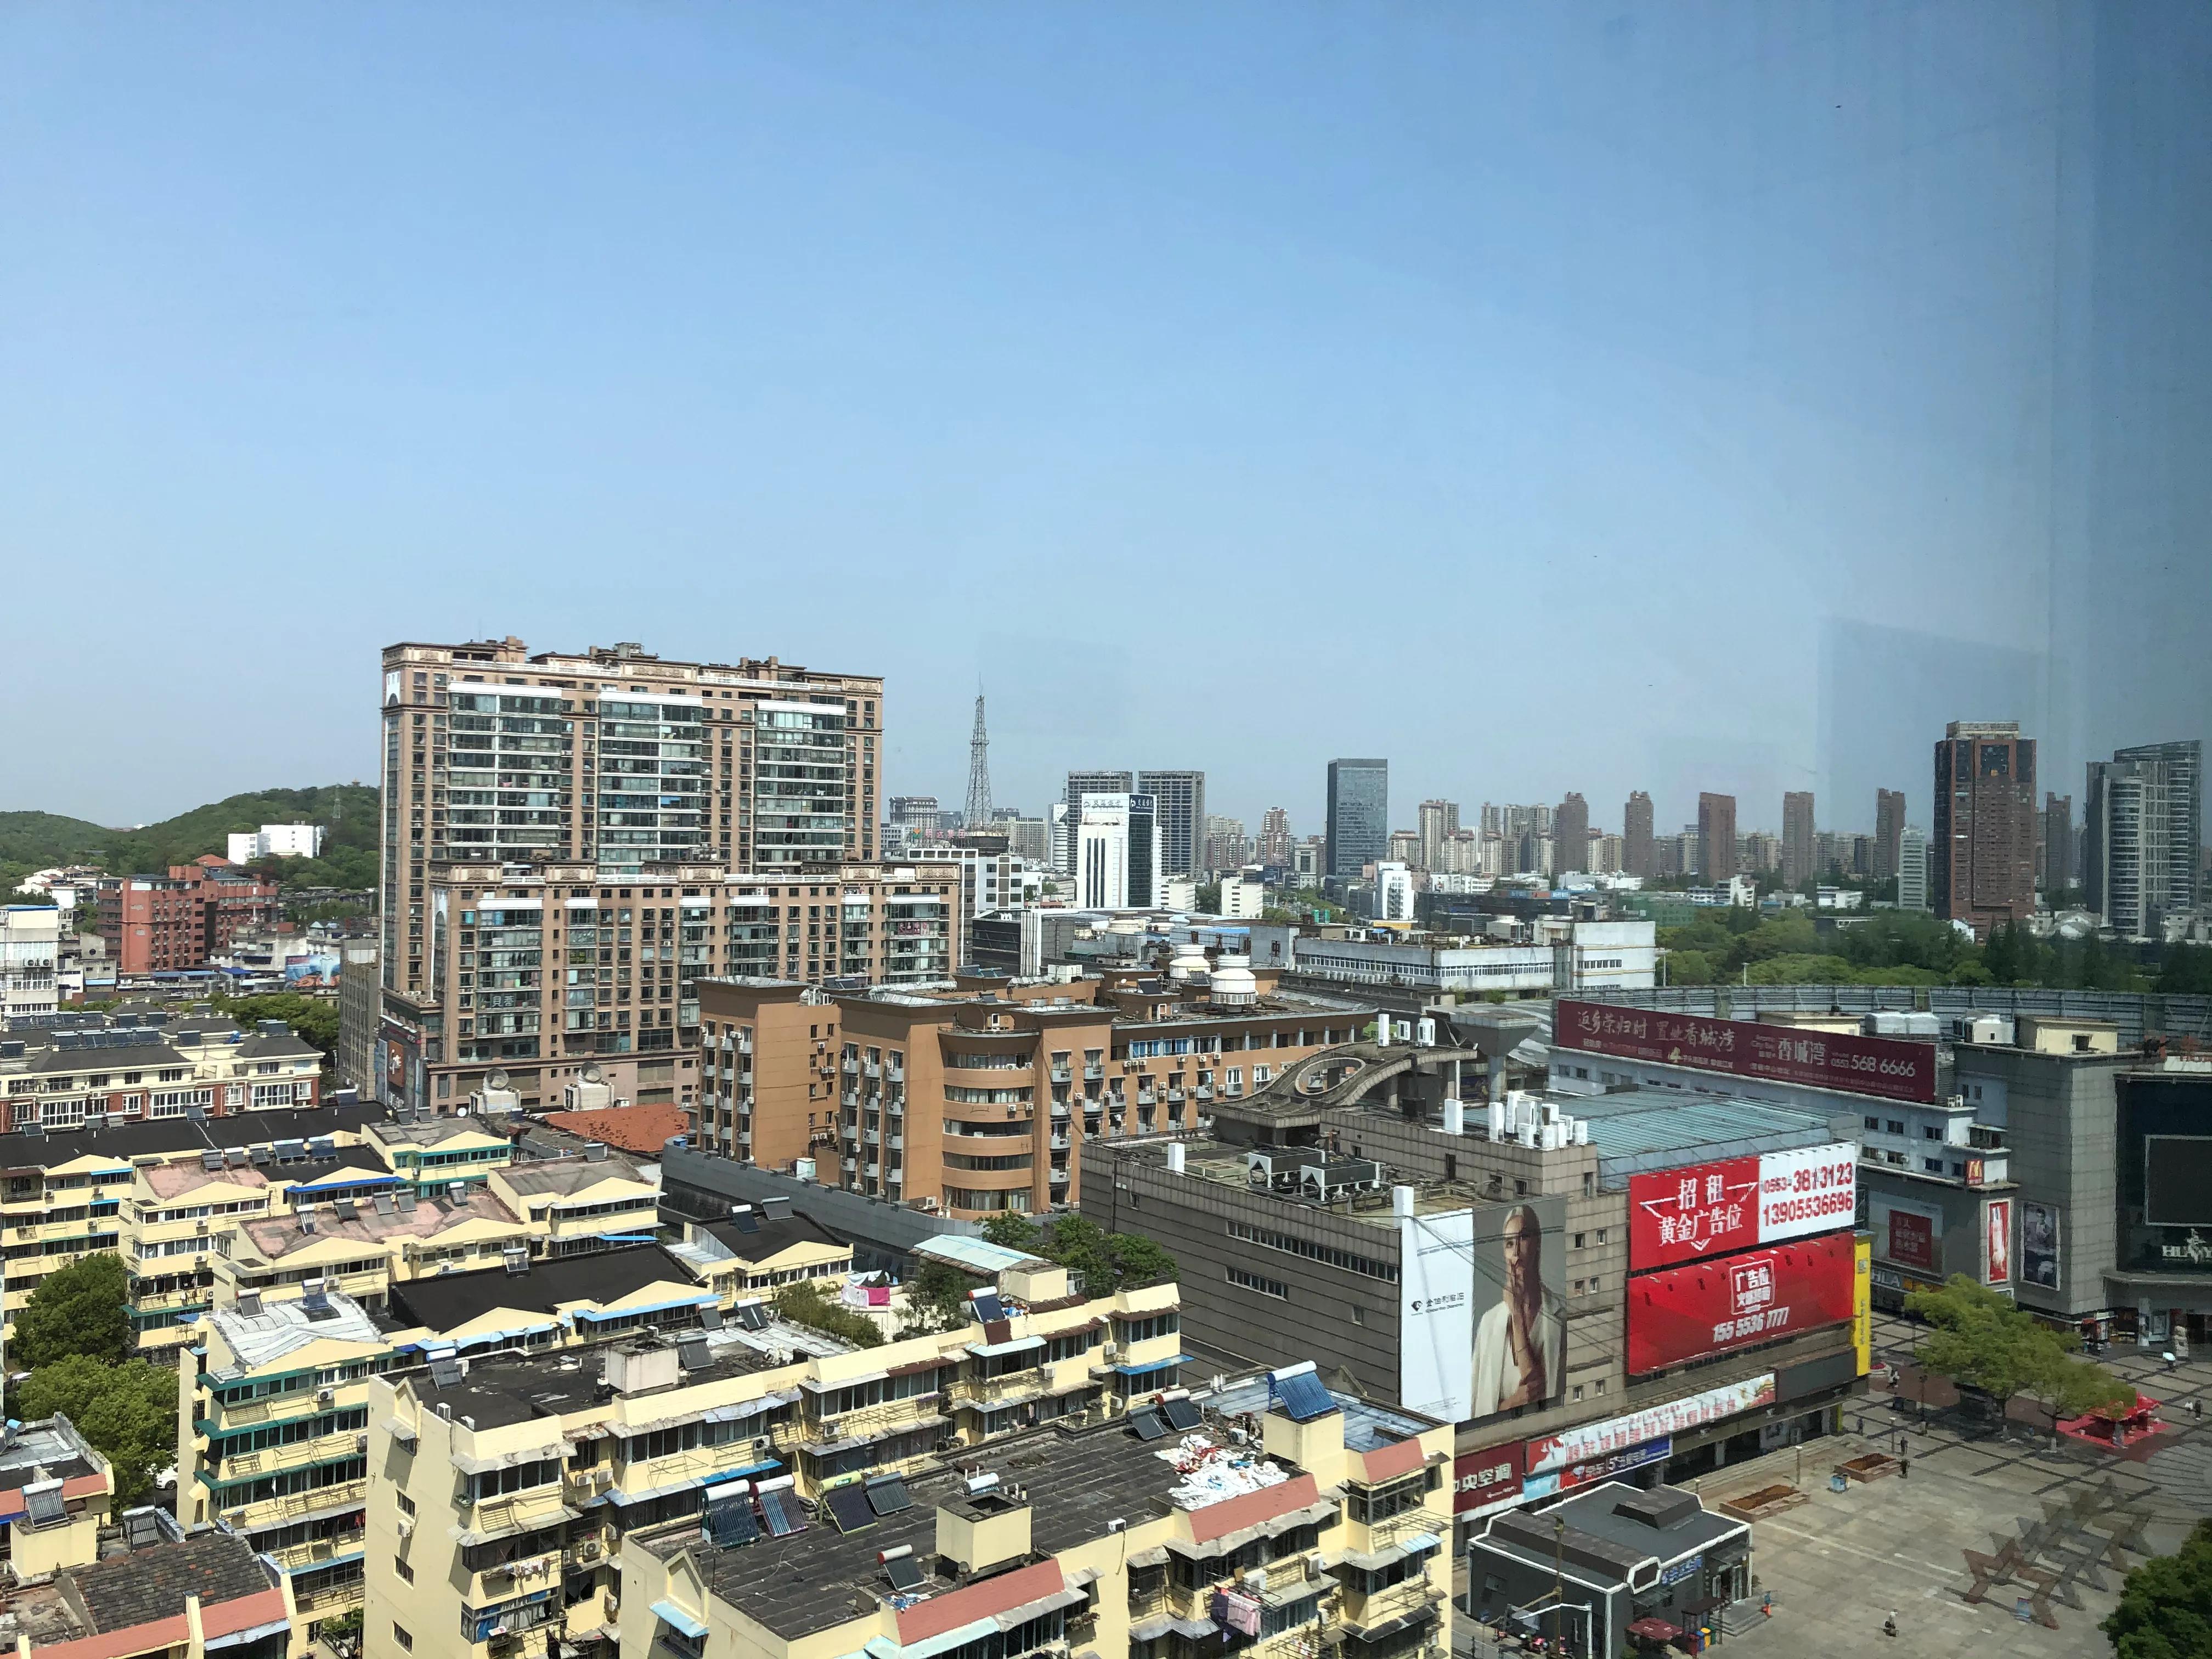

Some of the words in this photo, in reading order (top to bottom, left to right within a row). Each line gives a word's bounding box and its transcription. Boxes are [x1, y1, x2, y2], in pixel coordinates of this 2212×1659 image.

[1879, 1058, 1916, 1077] 6666
[1678, 1174, 1725, 1210] 招租
[1763, 1190, 1853, 1227] 13905536696
[1658, 1203, 1745, 1247] 黄金广告位
[1735, 1266, 1770, 1292] 广告位
